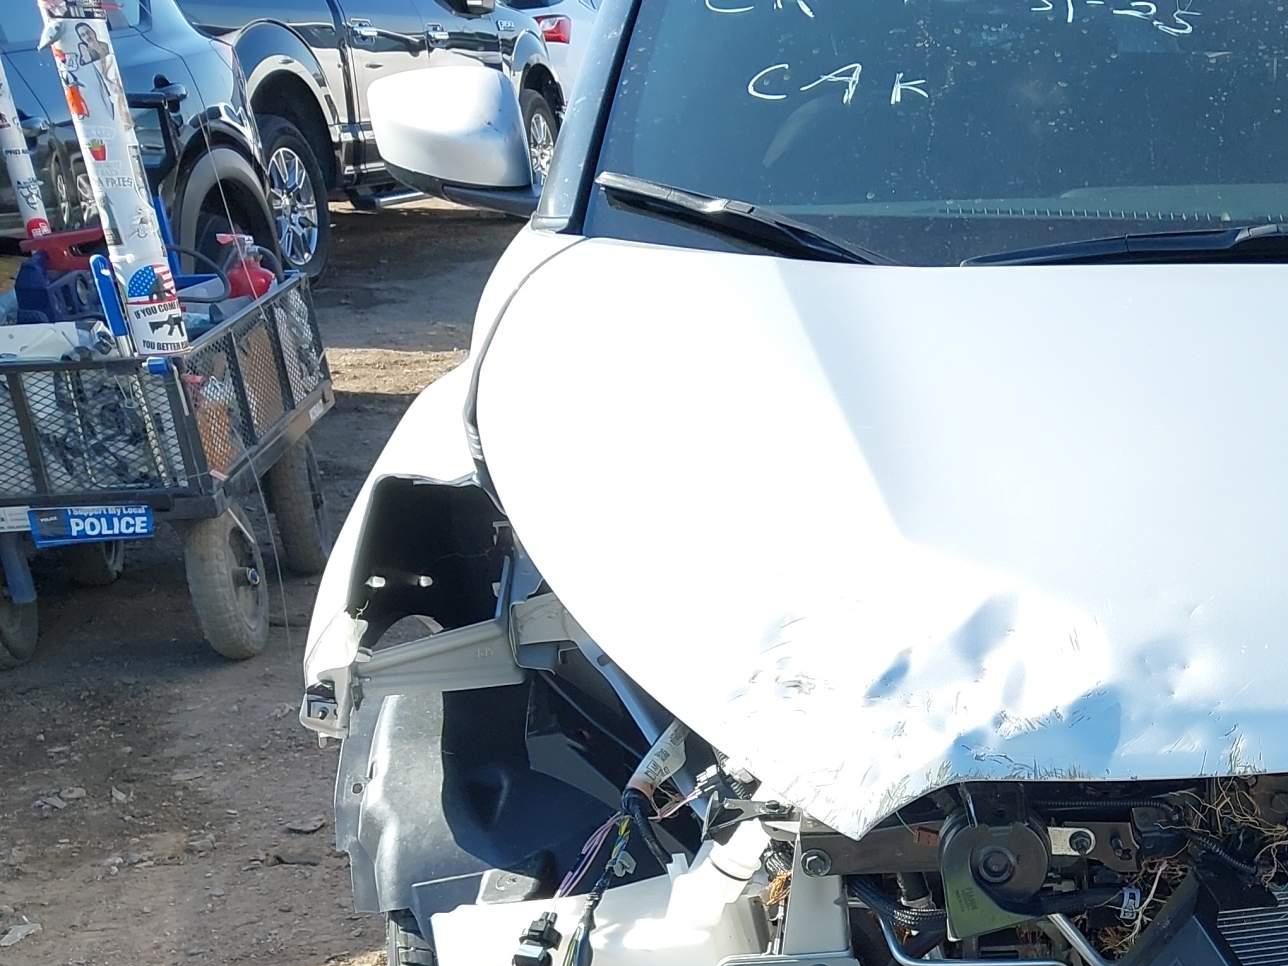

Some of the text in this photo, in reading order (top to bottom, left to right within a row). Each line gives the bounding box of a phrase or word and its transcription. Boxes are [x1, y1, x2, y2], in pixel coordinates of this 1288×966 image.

[142, 306, 158, 317] YOU
[142, 339, 155, 350] YOU
[156, 342, 181, 351] BETTER
[108, 507, 121, 516] My
[122, 506, 146, 515] Local
[70, 516, 148, 537] POLICE
